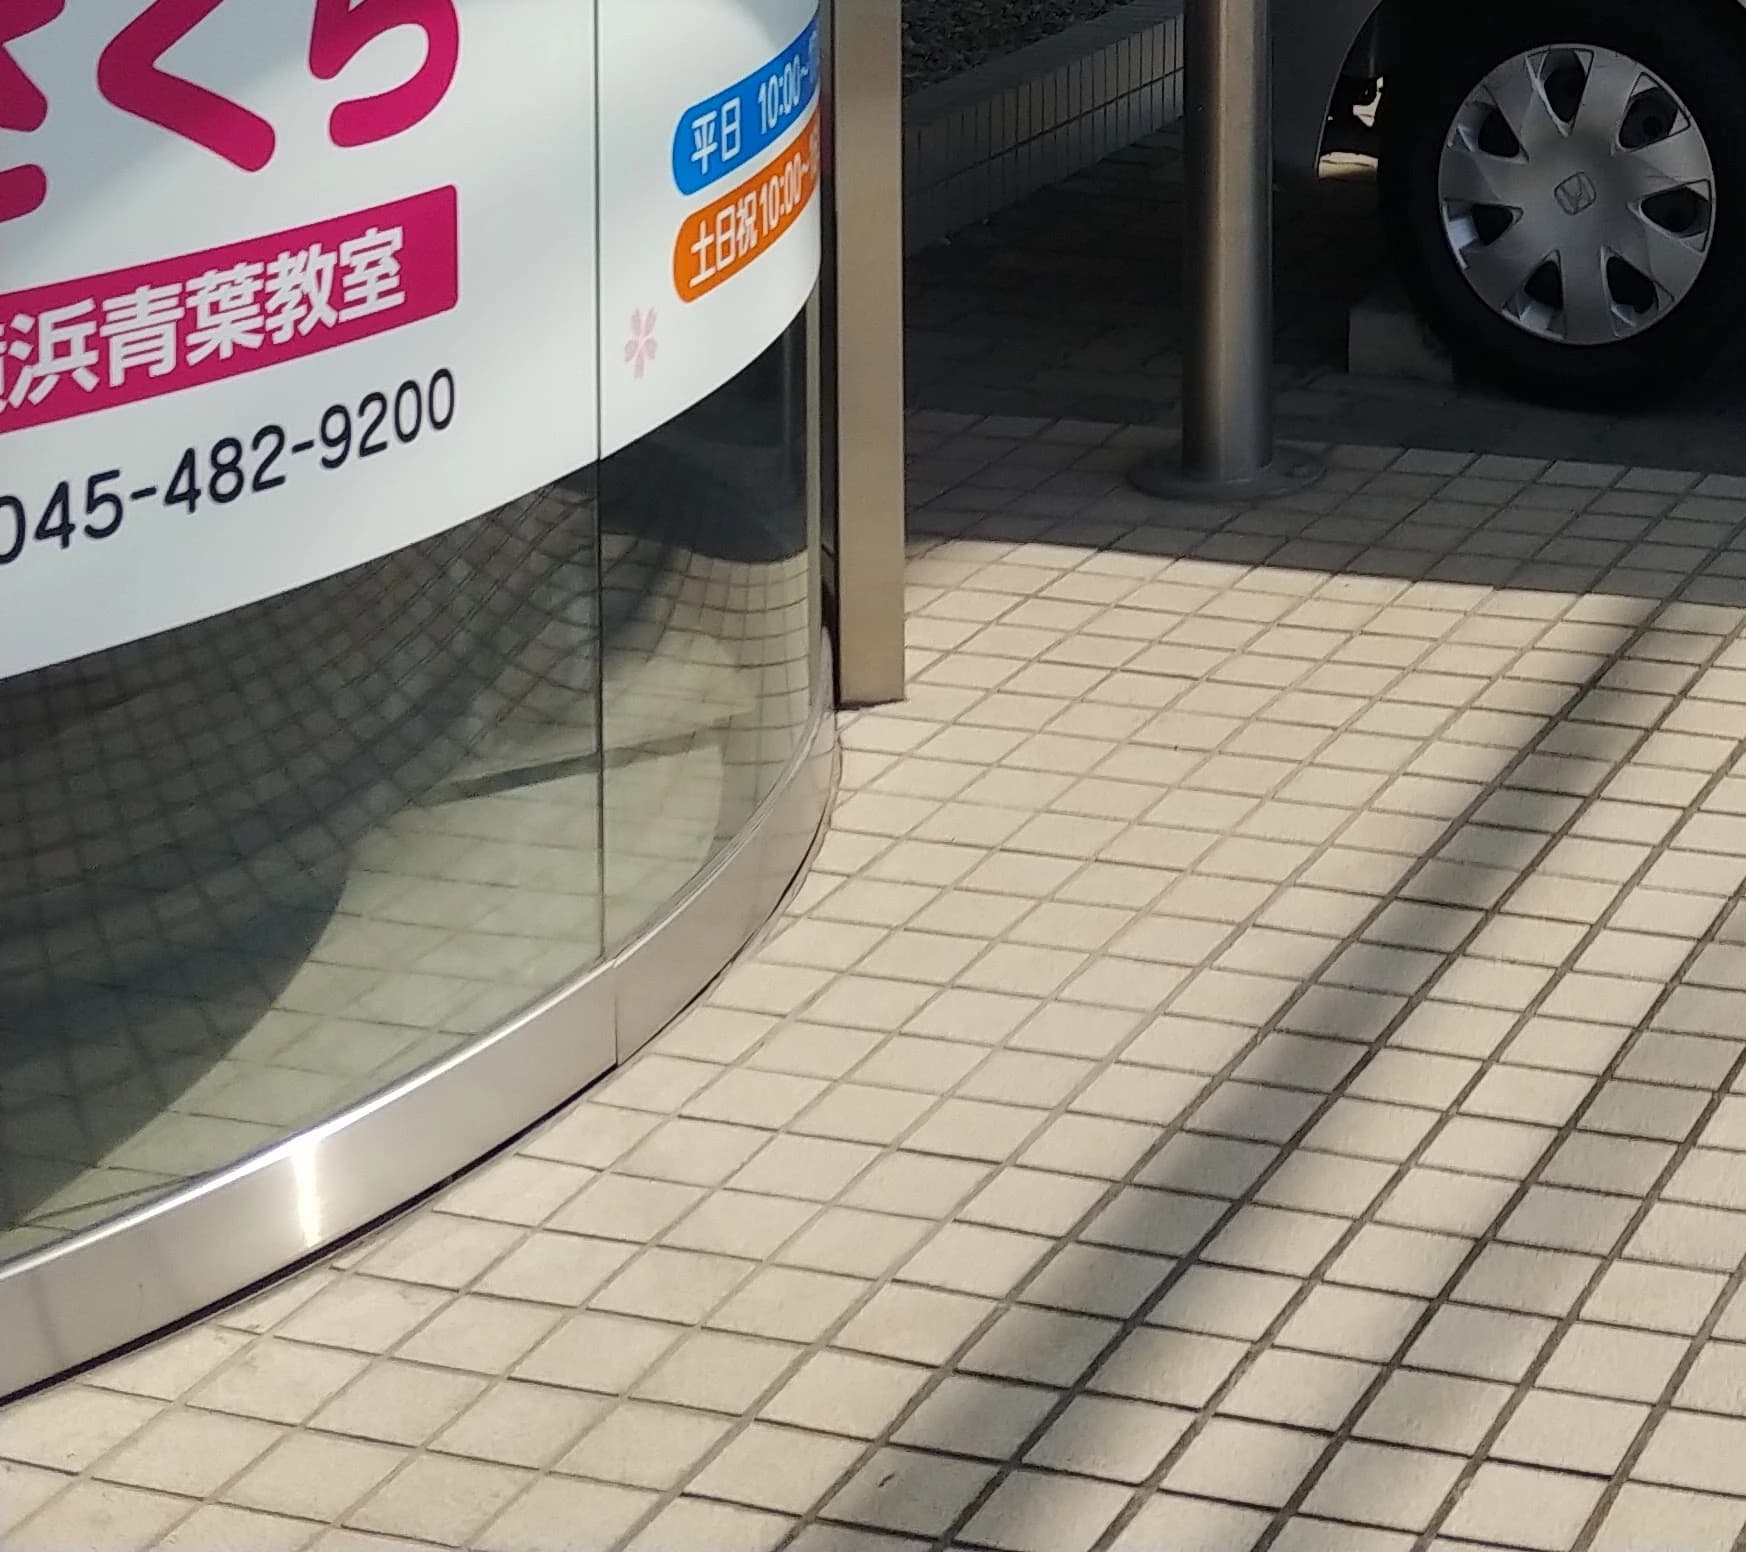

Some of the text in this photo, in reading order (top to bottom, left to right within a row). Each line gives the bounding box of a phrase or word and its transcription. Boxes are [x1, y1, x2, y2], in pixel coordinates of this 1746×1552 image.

[690, 96, 741, 176] 平日
[689, 190, 759, 289] 土日祝
[0, 226, 405, 408] 浜青葉教室
[0, 367, 456, 565] 045-482-9200
